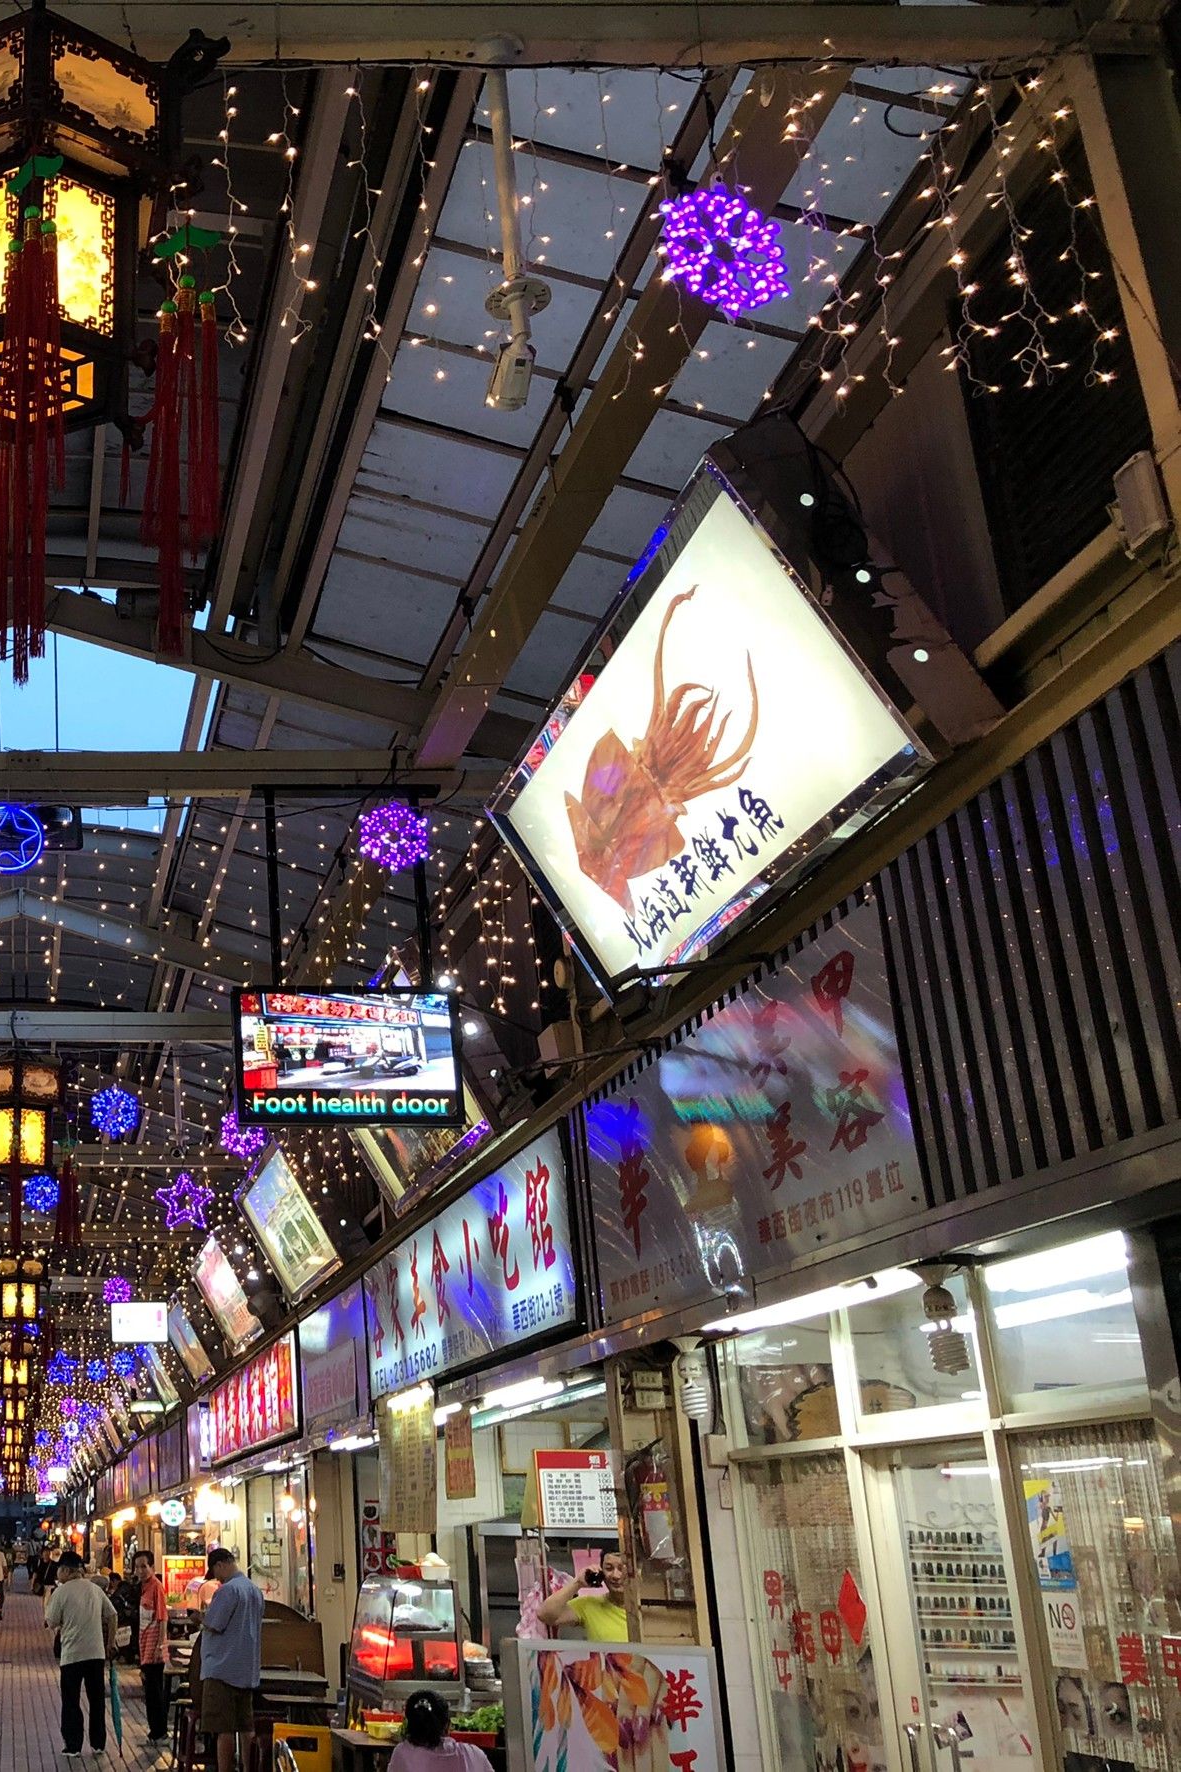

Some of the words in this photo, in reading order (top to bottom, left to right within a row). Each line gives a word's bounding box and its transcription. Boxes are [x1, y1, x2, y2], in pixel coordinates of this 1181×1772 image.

[253, 1092, 307, 1113] Foot
[312, 1091, 386, 1113] health
[391, 1091, 450, 1113] door
